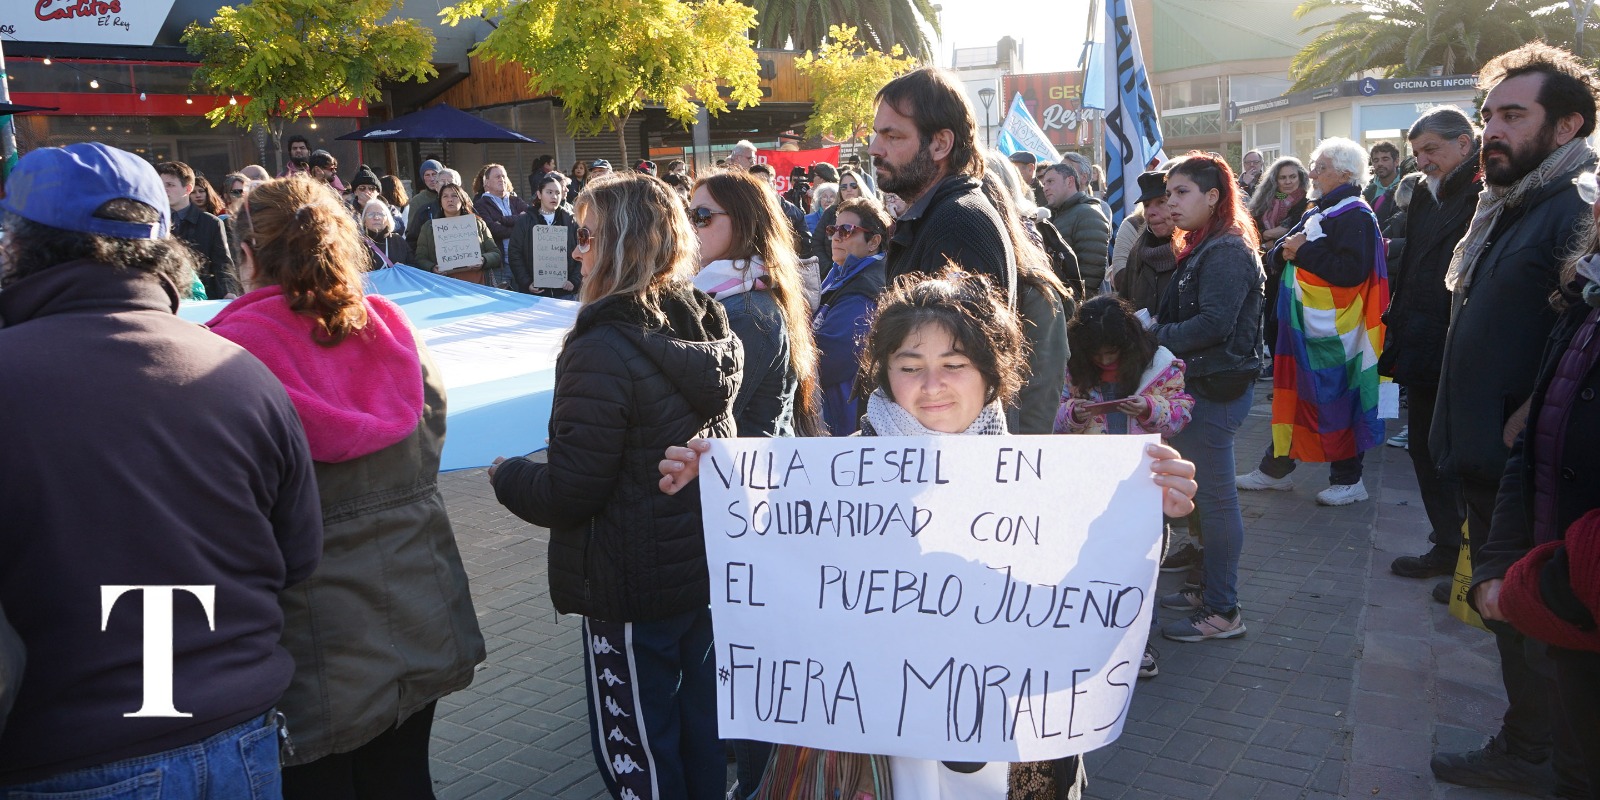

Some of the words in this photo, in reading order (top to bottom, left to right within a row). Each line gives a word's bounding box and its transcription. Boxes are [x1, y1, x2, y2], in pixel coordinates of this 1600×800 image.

[35, 0, 121, 21] Carlitos
[98, 15, 110, 26] El
[113, 16, 130, 31] Rey
[1393, 80, 1429, 90] OFICINA
[1430, 79, 1442, 88] DE
[1443, 77, 1478, 87] INFORM
[711, 449, 811, 490] VILLA
[830, 448, 950, 487] GESELL
[995, 448, 1042, 484] EN
[725, 500, 932, 539] SOLIDARIDAD
[970, 511, 1040, 546] CON
[726, 562, 766, 607] EL
[819, 564, 963, 618] PUEBLO
[974, 565, 1144, 629] JUJEÑO
[897, 656, 1131, 744] MORALES
